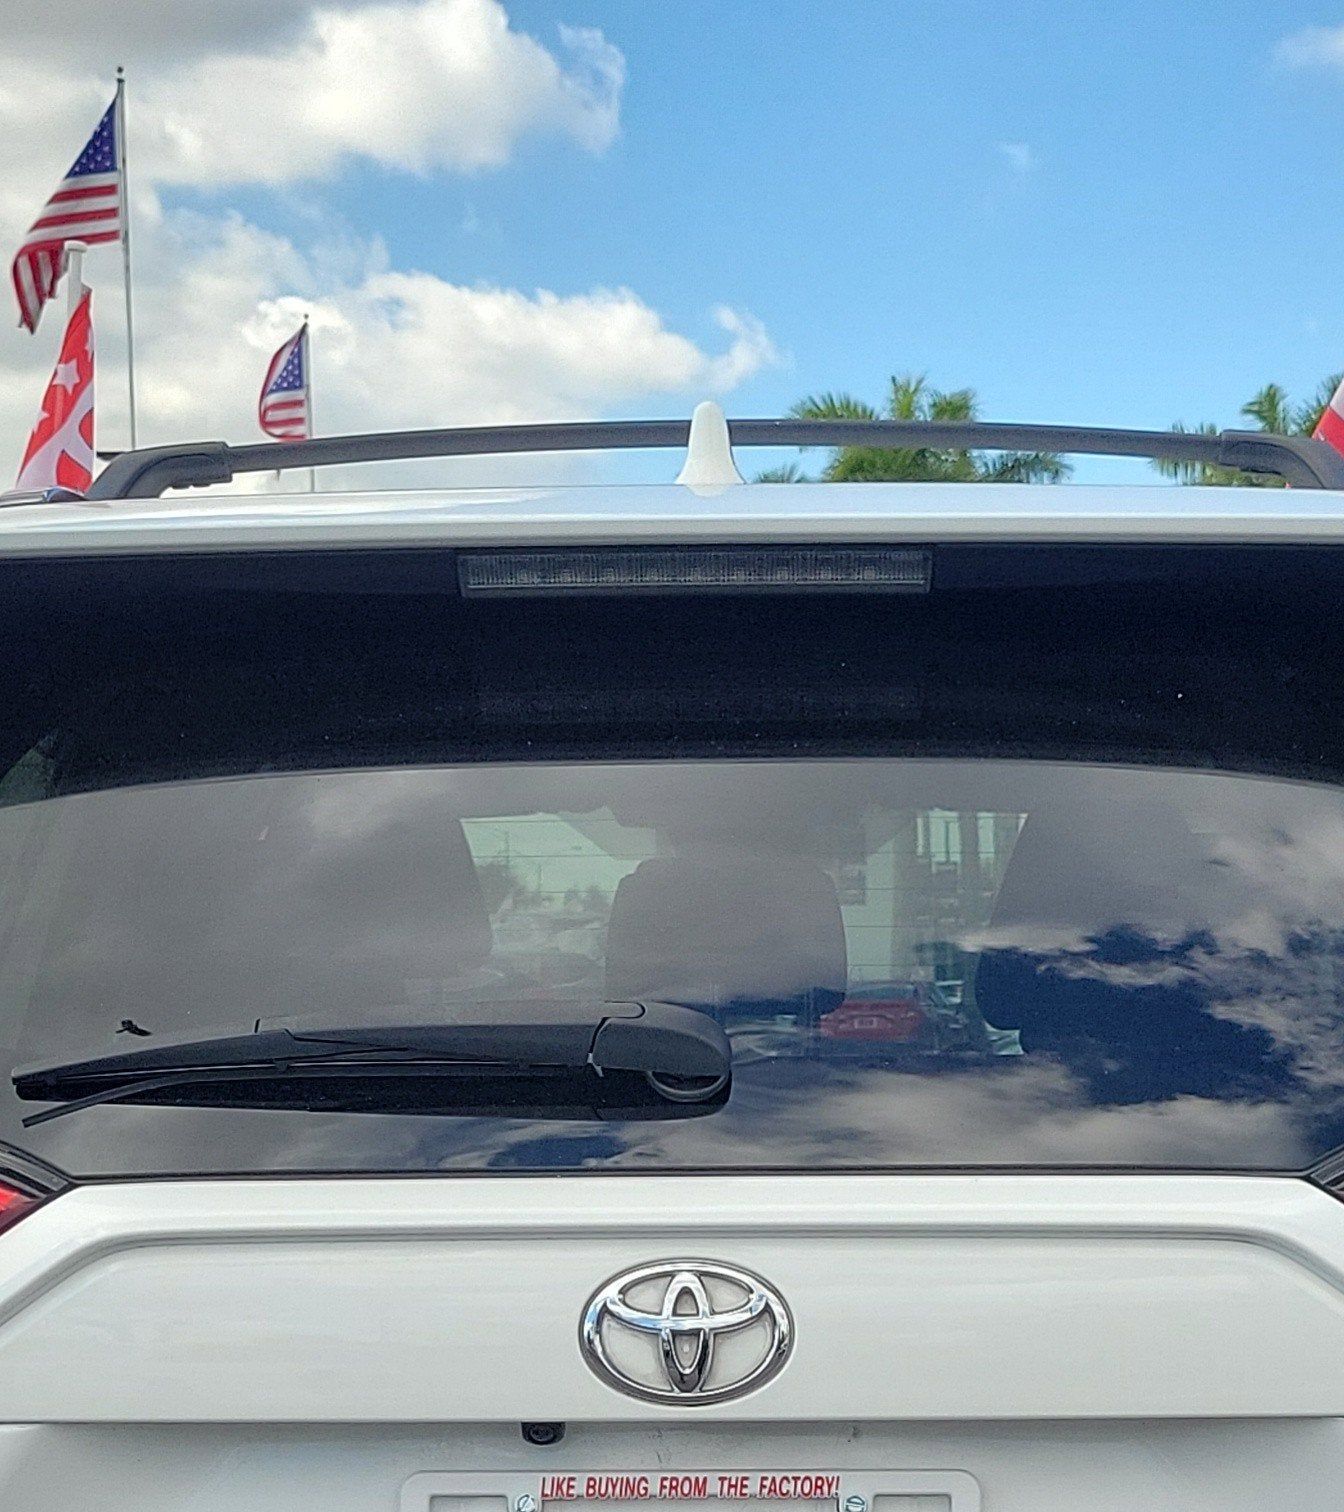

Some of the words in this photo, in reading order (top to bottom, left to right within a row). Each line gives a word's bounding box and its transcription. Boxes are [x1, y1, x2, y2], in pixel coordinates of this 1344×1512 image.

[540, 1476, 577, 1498] LIKE
[585, 1476, 649, 1498] BUYING
[658, 1476, 708, 1497] FROM
[718, 1476, 750, 1497] THE
[758, 1475, 841, 1498] FACTORY!
